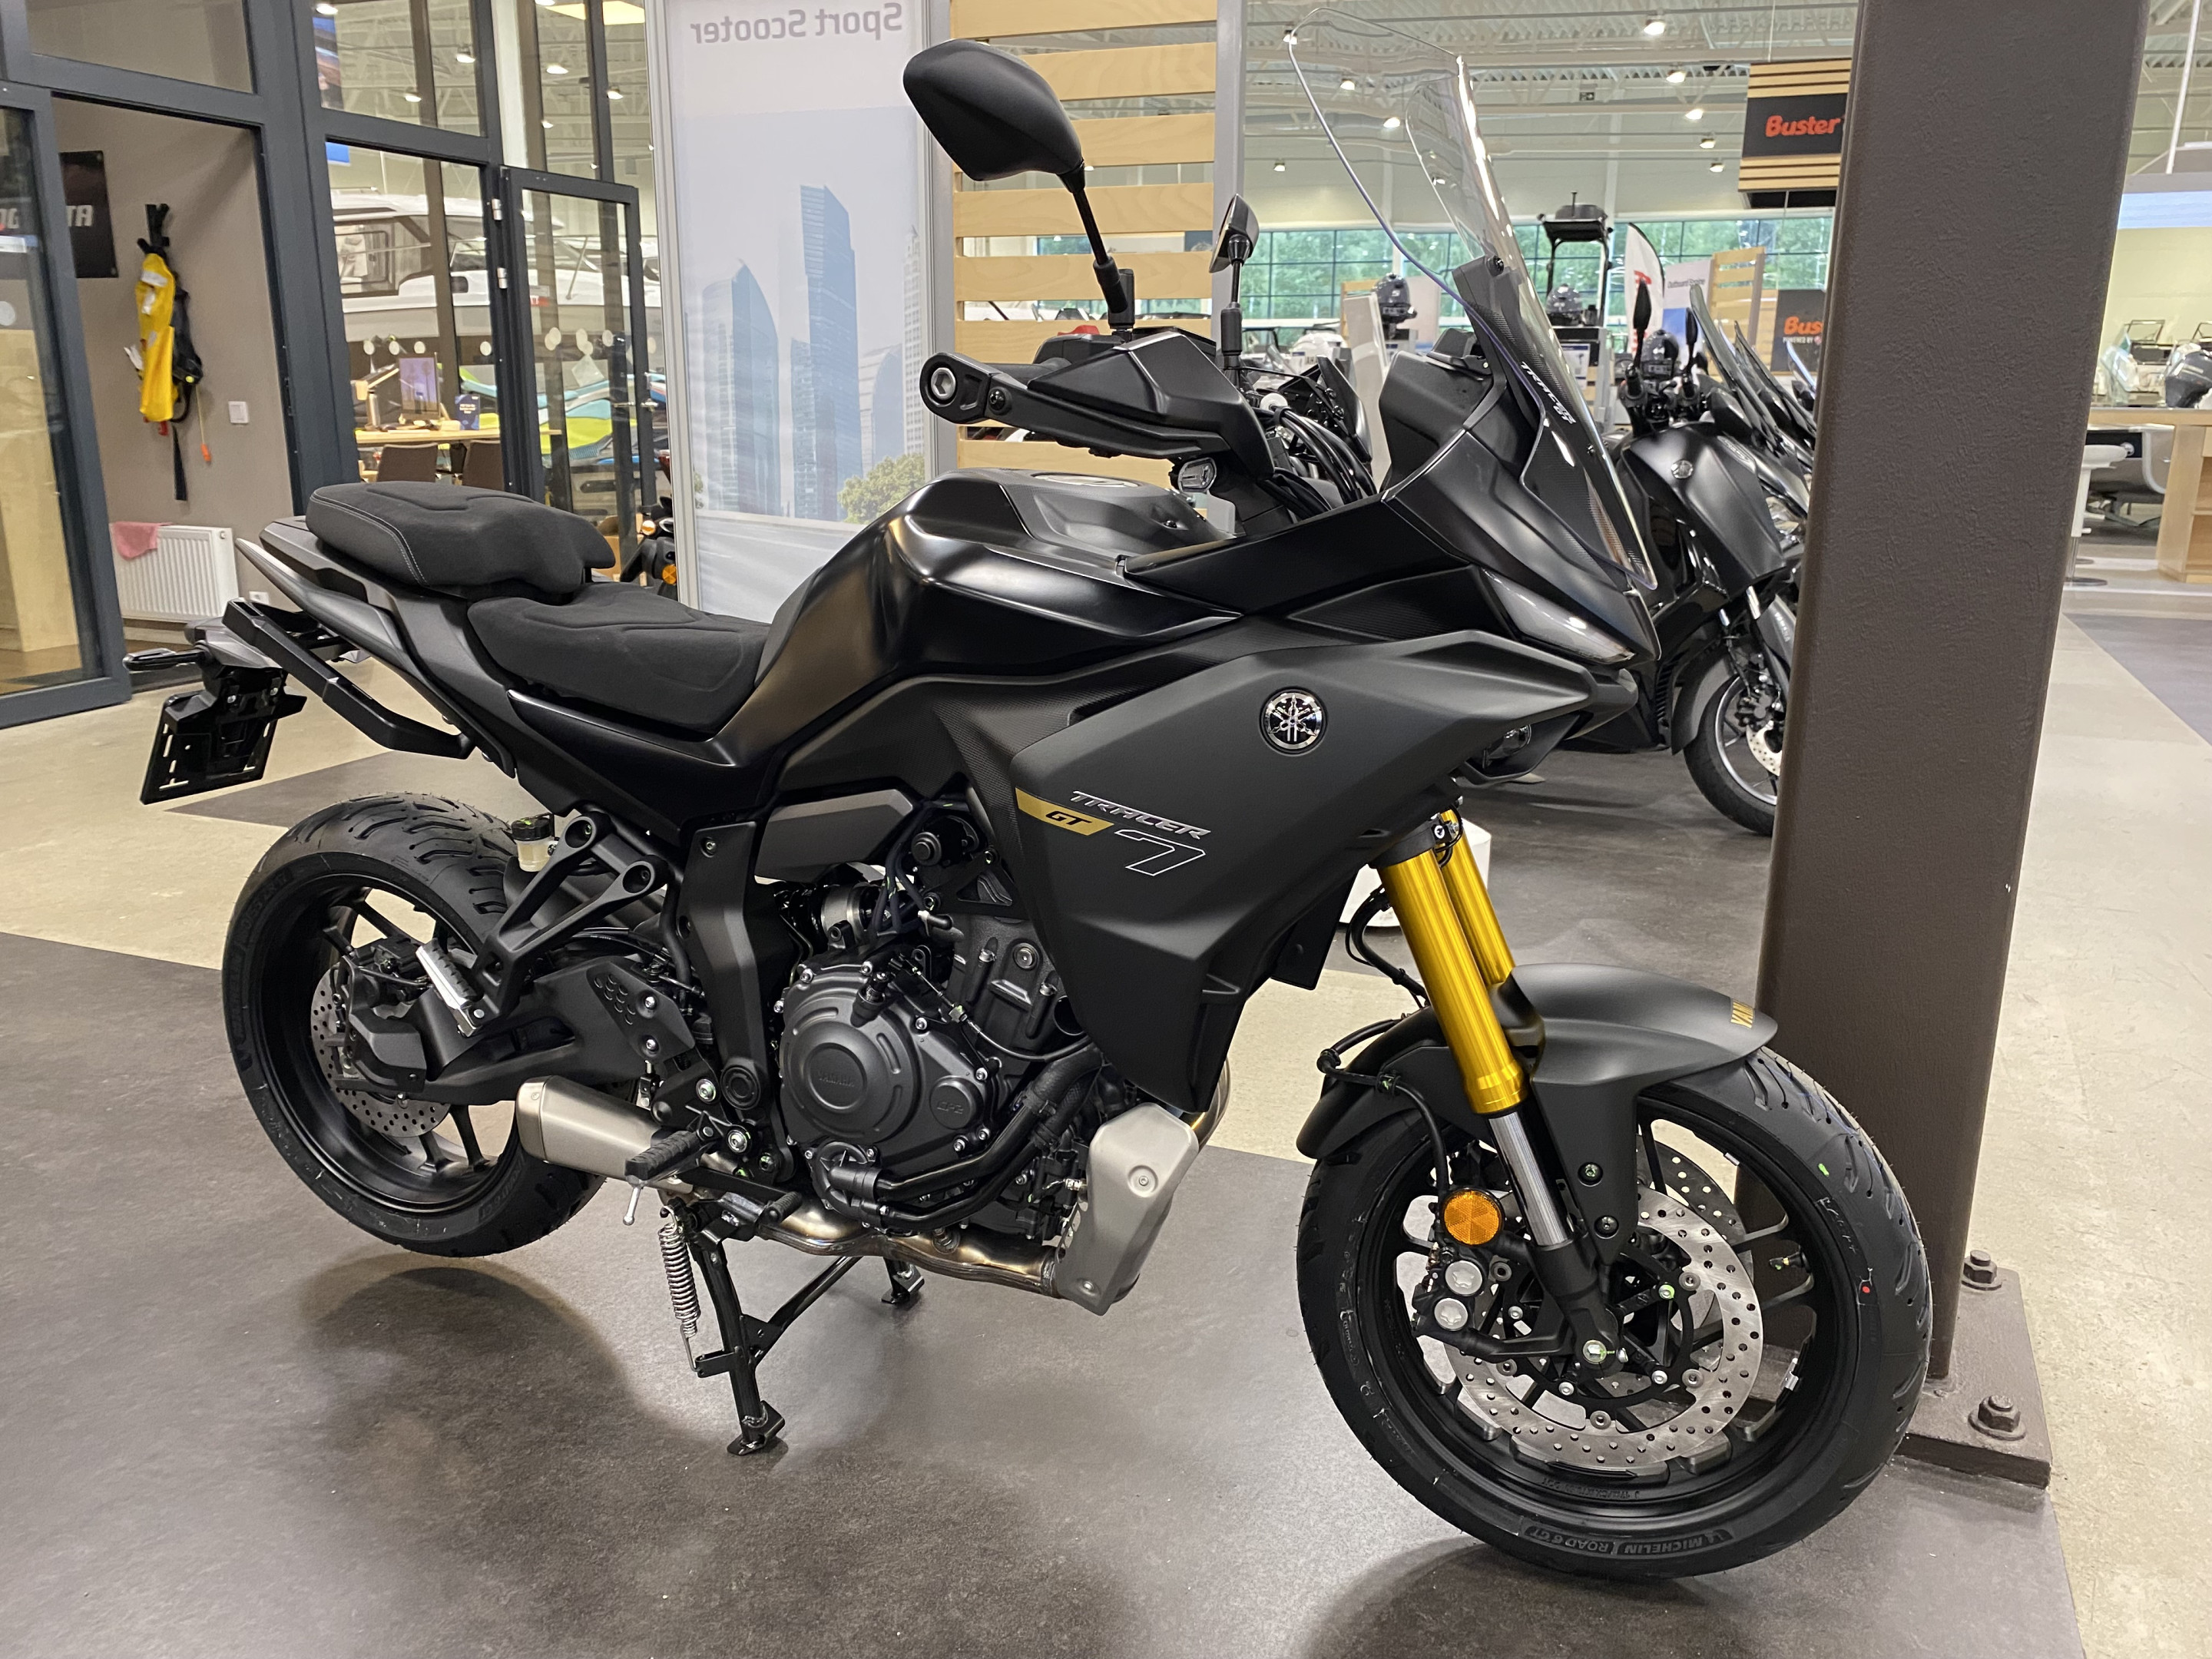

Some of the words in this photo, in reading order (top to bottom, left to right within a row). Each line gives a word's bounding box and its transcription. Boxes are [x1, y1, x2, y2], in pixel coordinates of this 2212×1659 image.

[1764, 114, 1841, 137] Buster
[1045, 810, 1092, 826] GT
[1070, 790, 1211, 839] TRACER
[1114, 829, 1206, 877] 7
[1564, 1538, 1609, 1552] ROAD
[1624, 1537, 1703, 1554] MICHELIN
